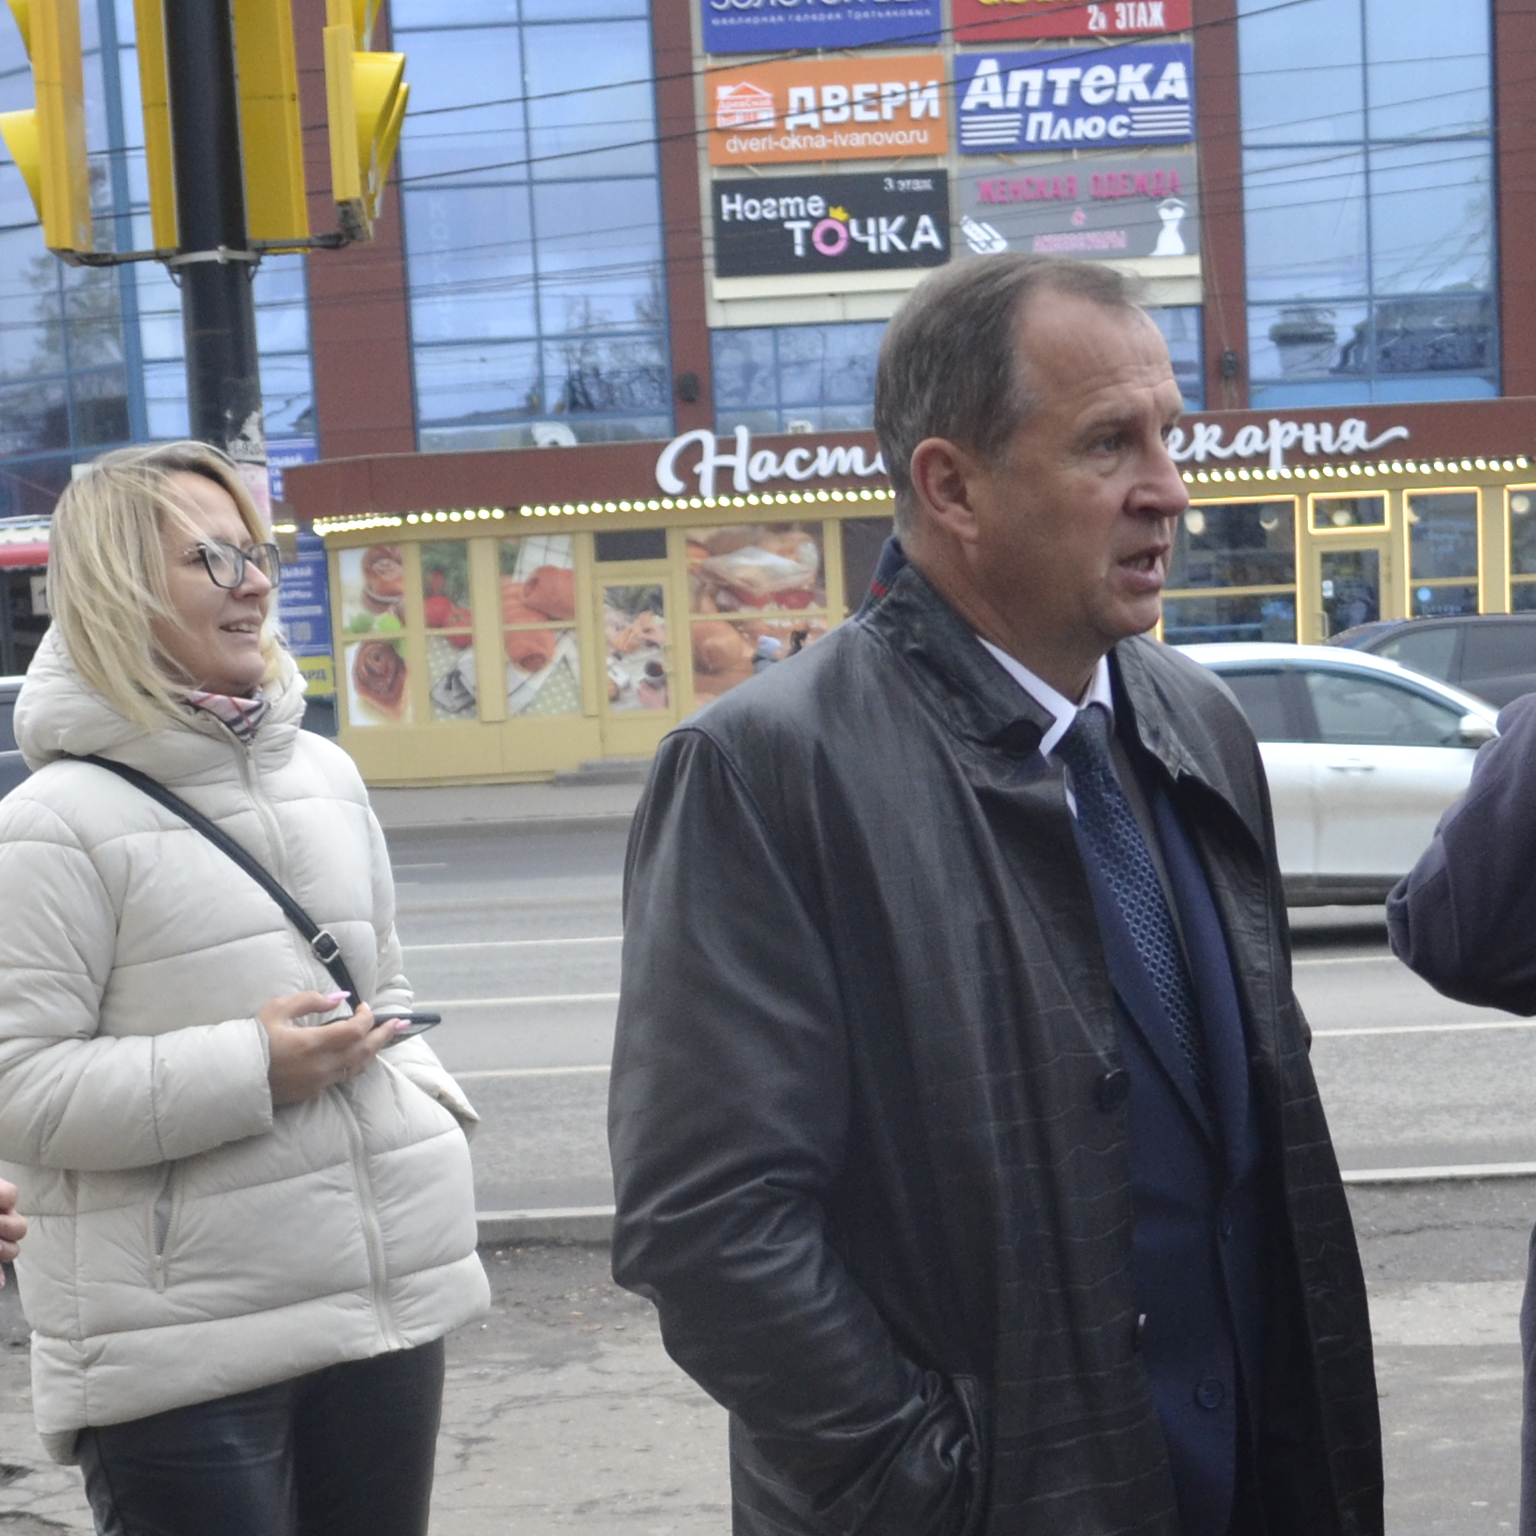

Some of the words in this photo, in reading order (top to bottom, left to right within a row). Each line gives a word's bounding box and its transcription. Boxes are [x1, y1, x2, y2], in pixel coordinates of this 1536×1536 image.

[1115, 1, 1164, 29] ЭТАЖ
[785, 79, 941, 130] ДВЕРИ
[725, 128, 930, 154] dveri-okna-ivanovo.ru
[1025, 111, 1131, 143] Плюс
[883, 177, 895, 192] 3
[897, 178, 934, 192] этаж
[977, 174, 1078, 203] ЖЕНСКАЯ
[1090, 170, 1182, 200] ОДЕЖДА
[720, 193, 825, 221] Ногте
[784, 214, 943, 257] ТОЧКА
[655, 424, 887, 499] Наст
[1167, 418, 1410, 472] екарня
